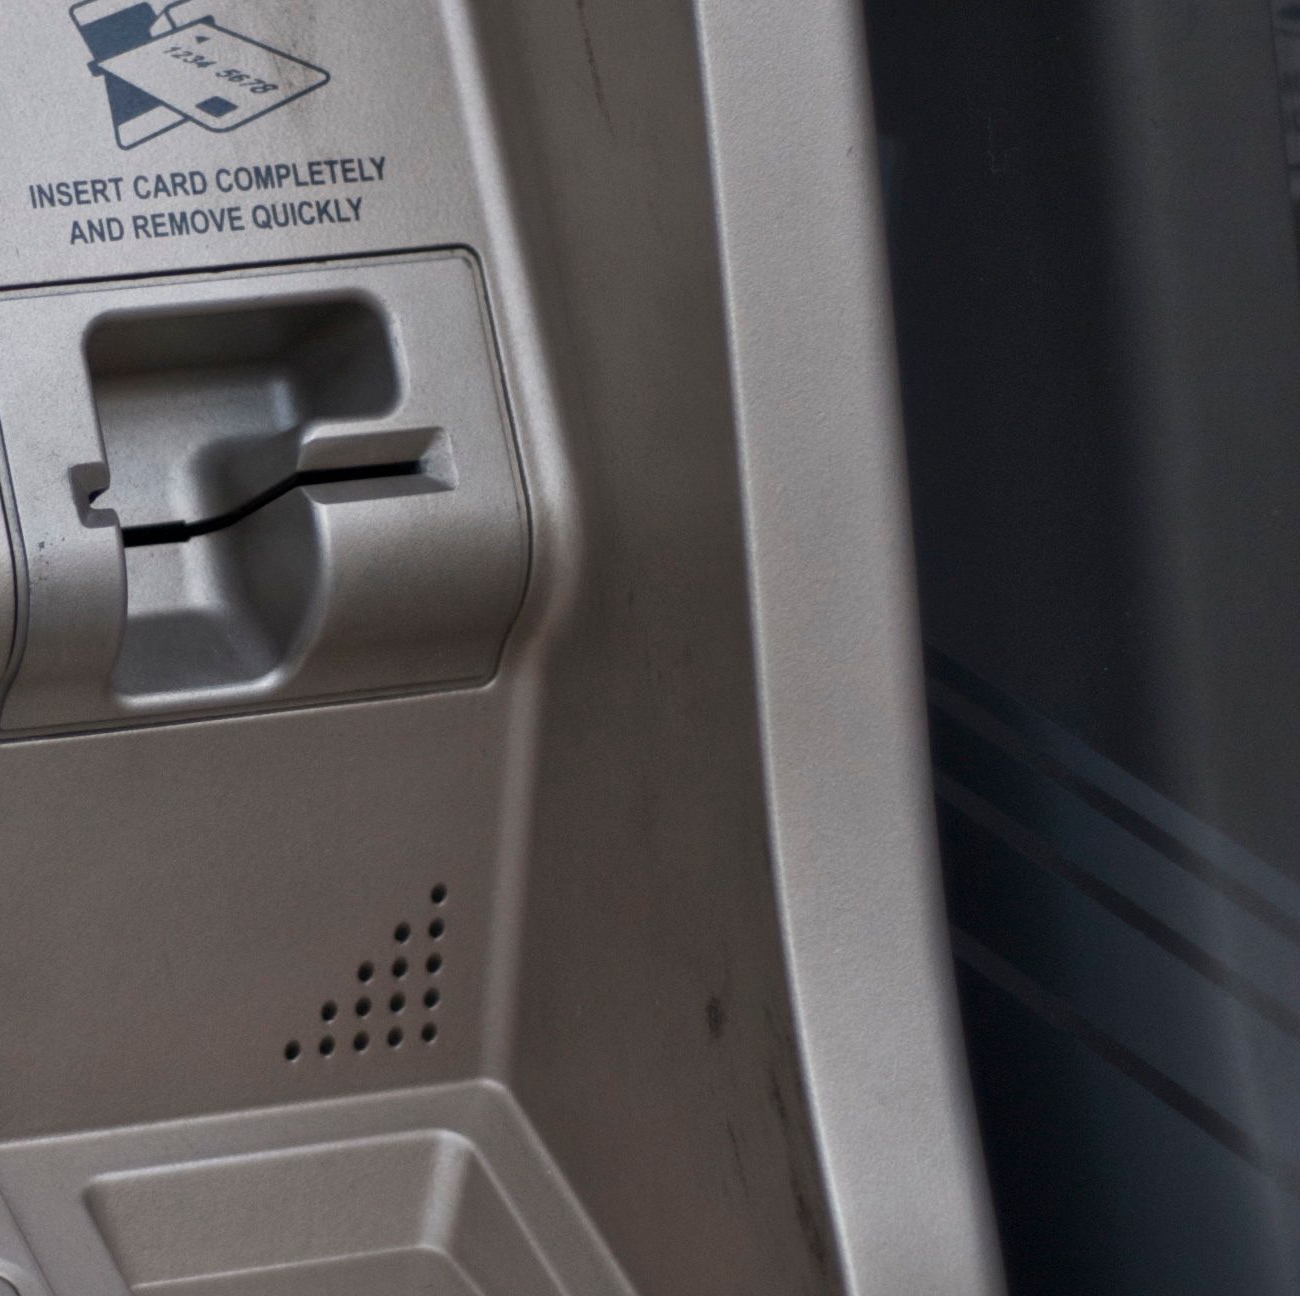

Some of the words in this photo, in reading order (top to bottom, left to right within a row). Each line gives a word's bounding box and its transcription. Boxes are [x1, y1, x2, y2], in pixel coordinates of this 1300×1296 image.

[163, 46, 218, 69] 1234
[214, 68, 279, 94] 5678
[29, 177, 124, 209] INSERT
[132, 170, 208, 200] CARD
[215, 156, 387, 193] COMPLETELY
[69, 217, 125, 245] AND
[134, 205, 246, 240] REMOVE
[251, 196, 363, 230] QUICKLY
